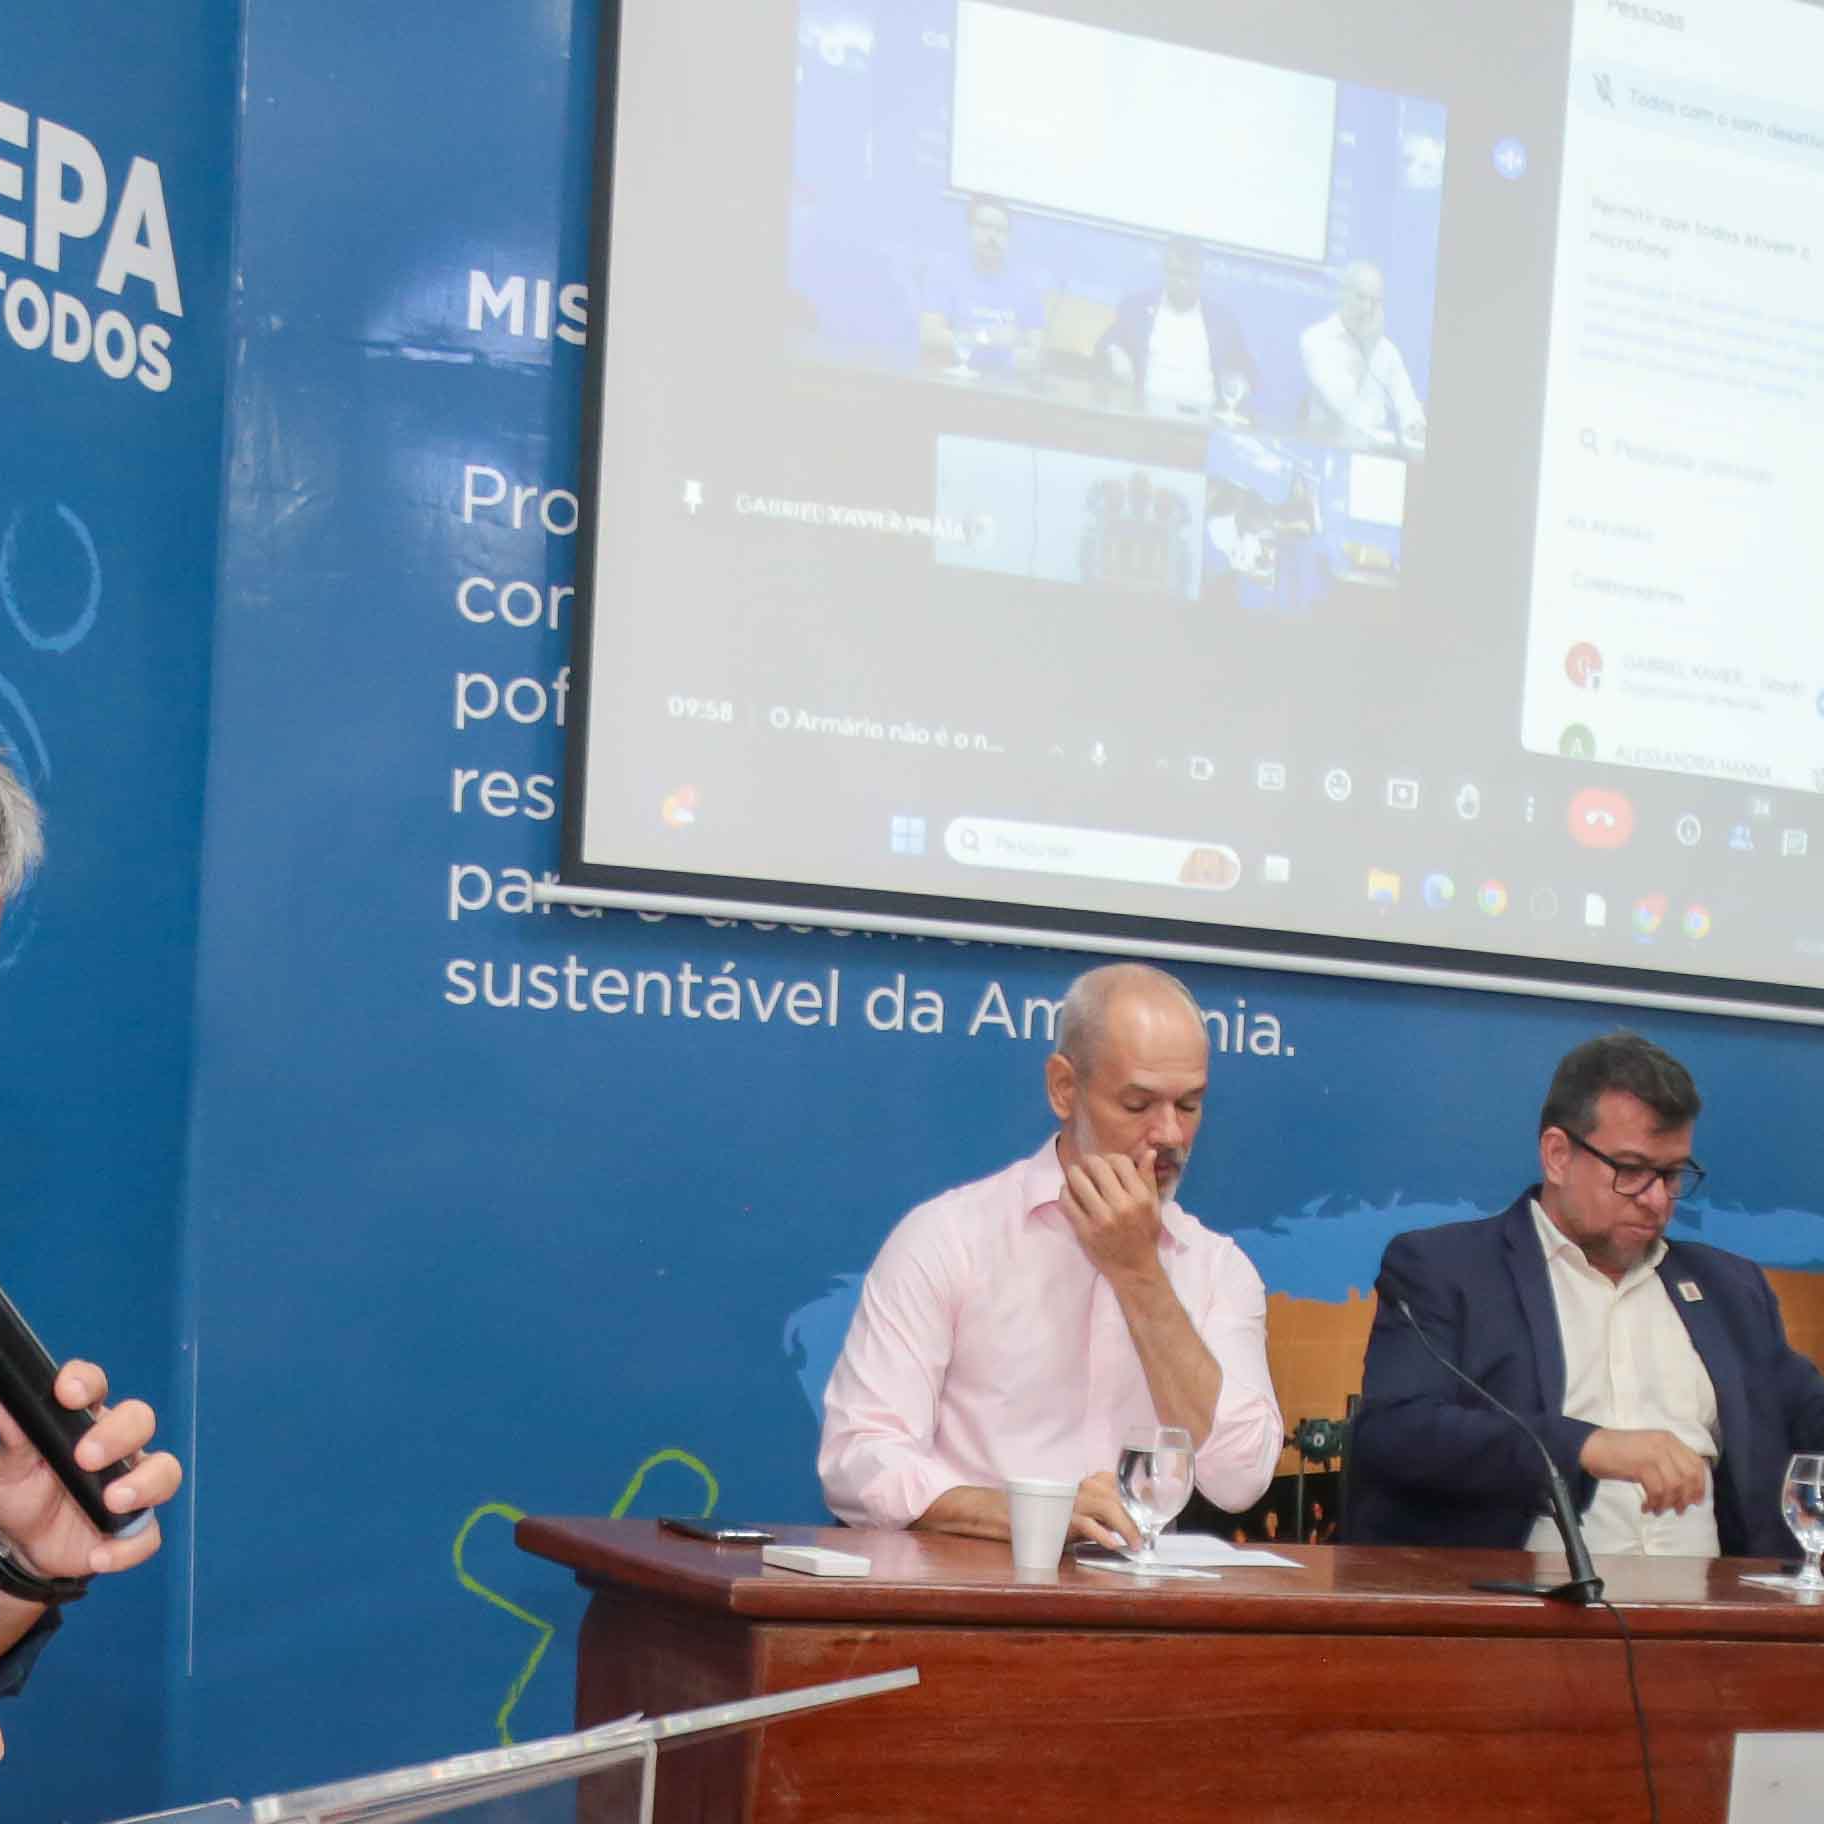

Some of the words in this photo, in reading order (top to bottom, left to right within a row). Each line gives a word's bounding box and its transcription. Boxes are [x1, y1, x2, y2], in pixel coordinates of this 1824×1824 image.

[462, 464, 578, 534] Pro
[666, 695, 735, 724] 09:58
[768, 705, 791, 730] O
[795, 709, 884, 742] Armário
[452, 767, 555, 820] res
[444, 955, 840, 1027] sustentável
[864, 973, 944, 1034] da
